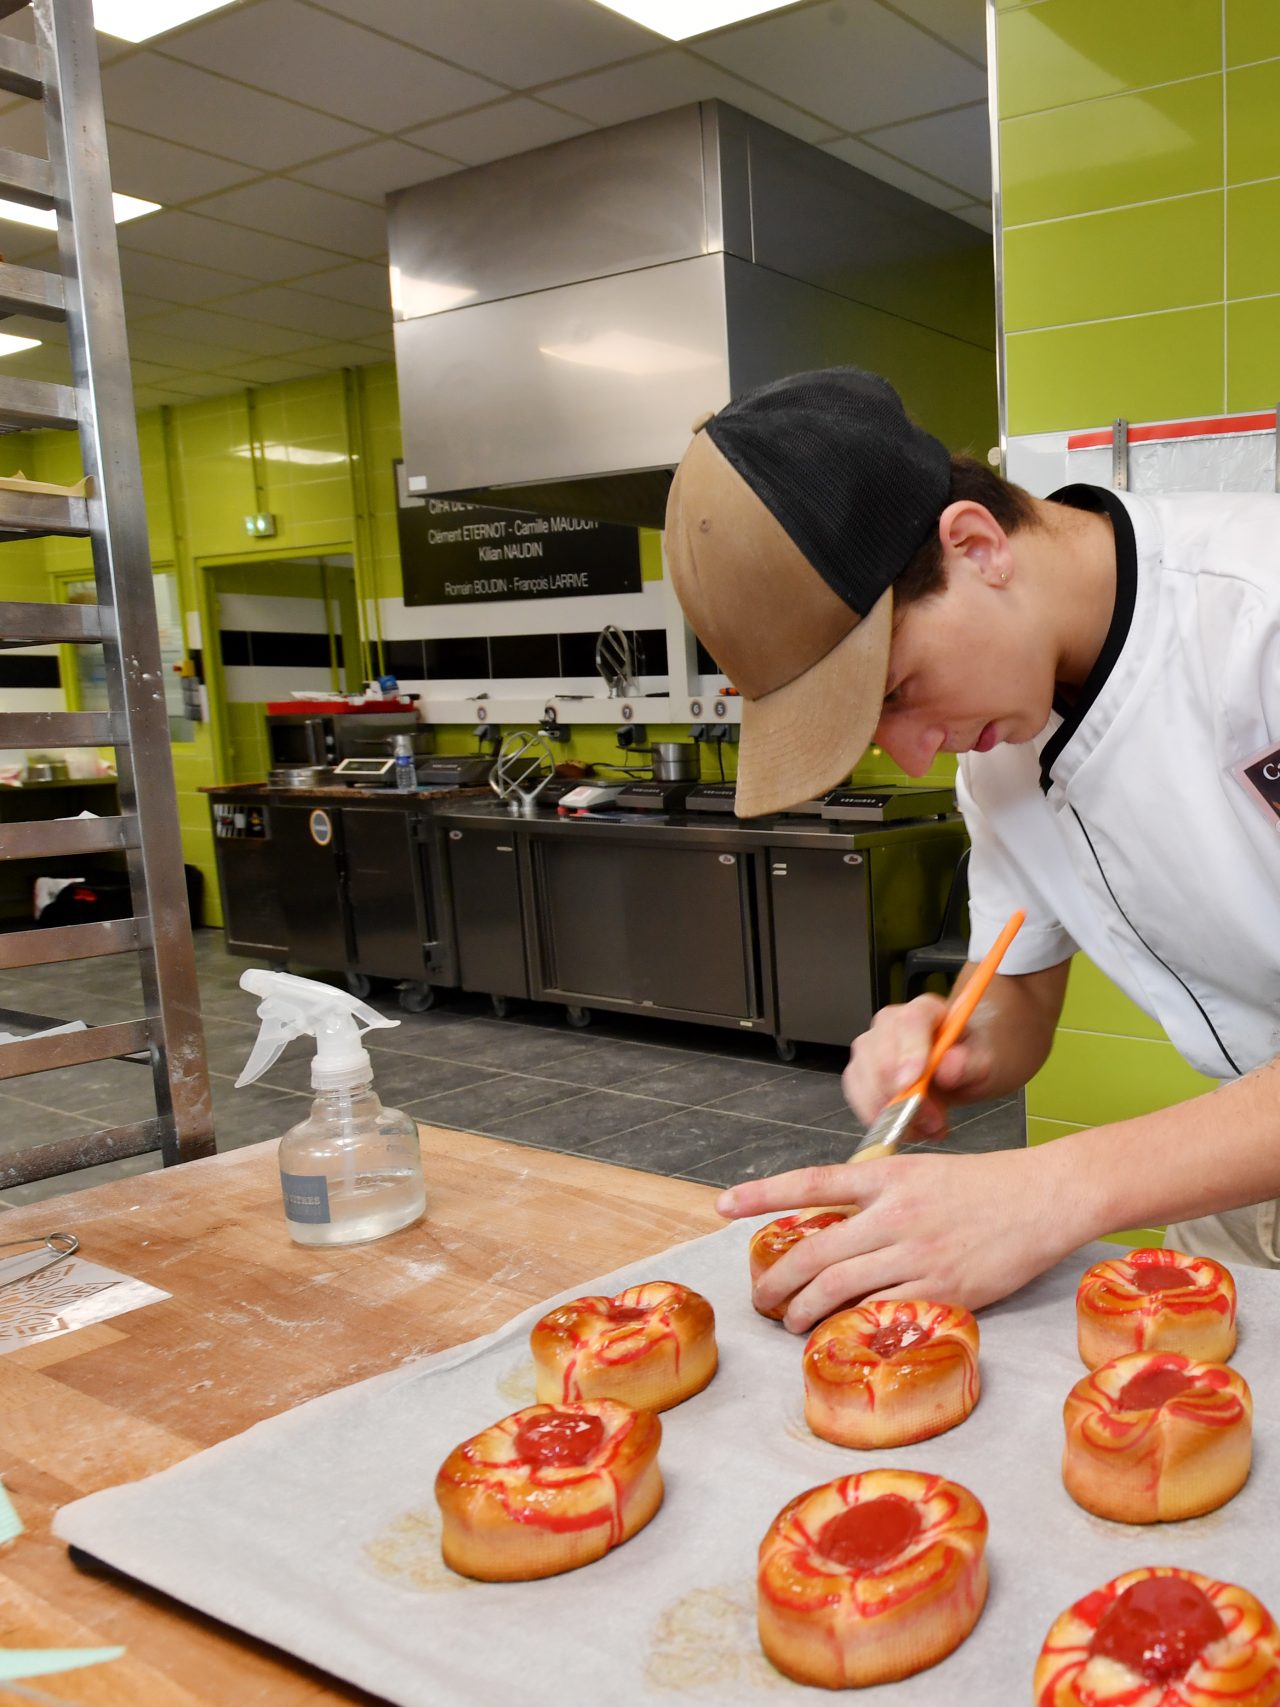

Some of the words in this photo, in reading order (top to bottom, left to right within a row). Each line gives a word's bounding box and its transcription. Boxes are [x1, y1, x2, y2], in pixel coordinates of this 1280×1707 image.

[463, 521, 507, 541] ETERNOT
[514, 520, 549, 536] Camille
[479, 547, 503, 561] Kilian
[503, 542, 544, 559] NAUDIN
[444, 582, 474, 596] Romain
[474, 578, 508, 594] BOUDIN
[514, 576, 549, 593] François
